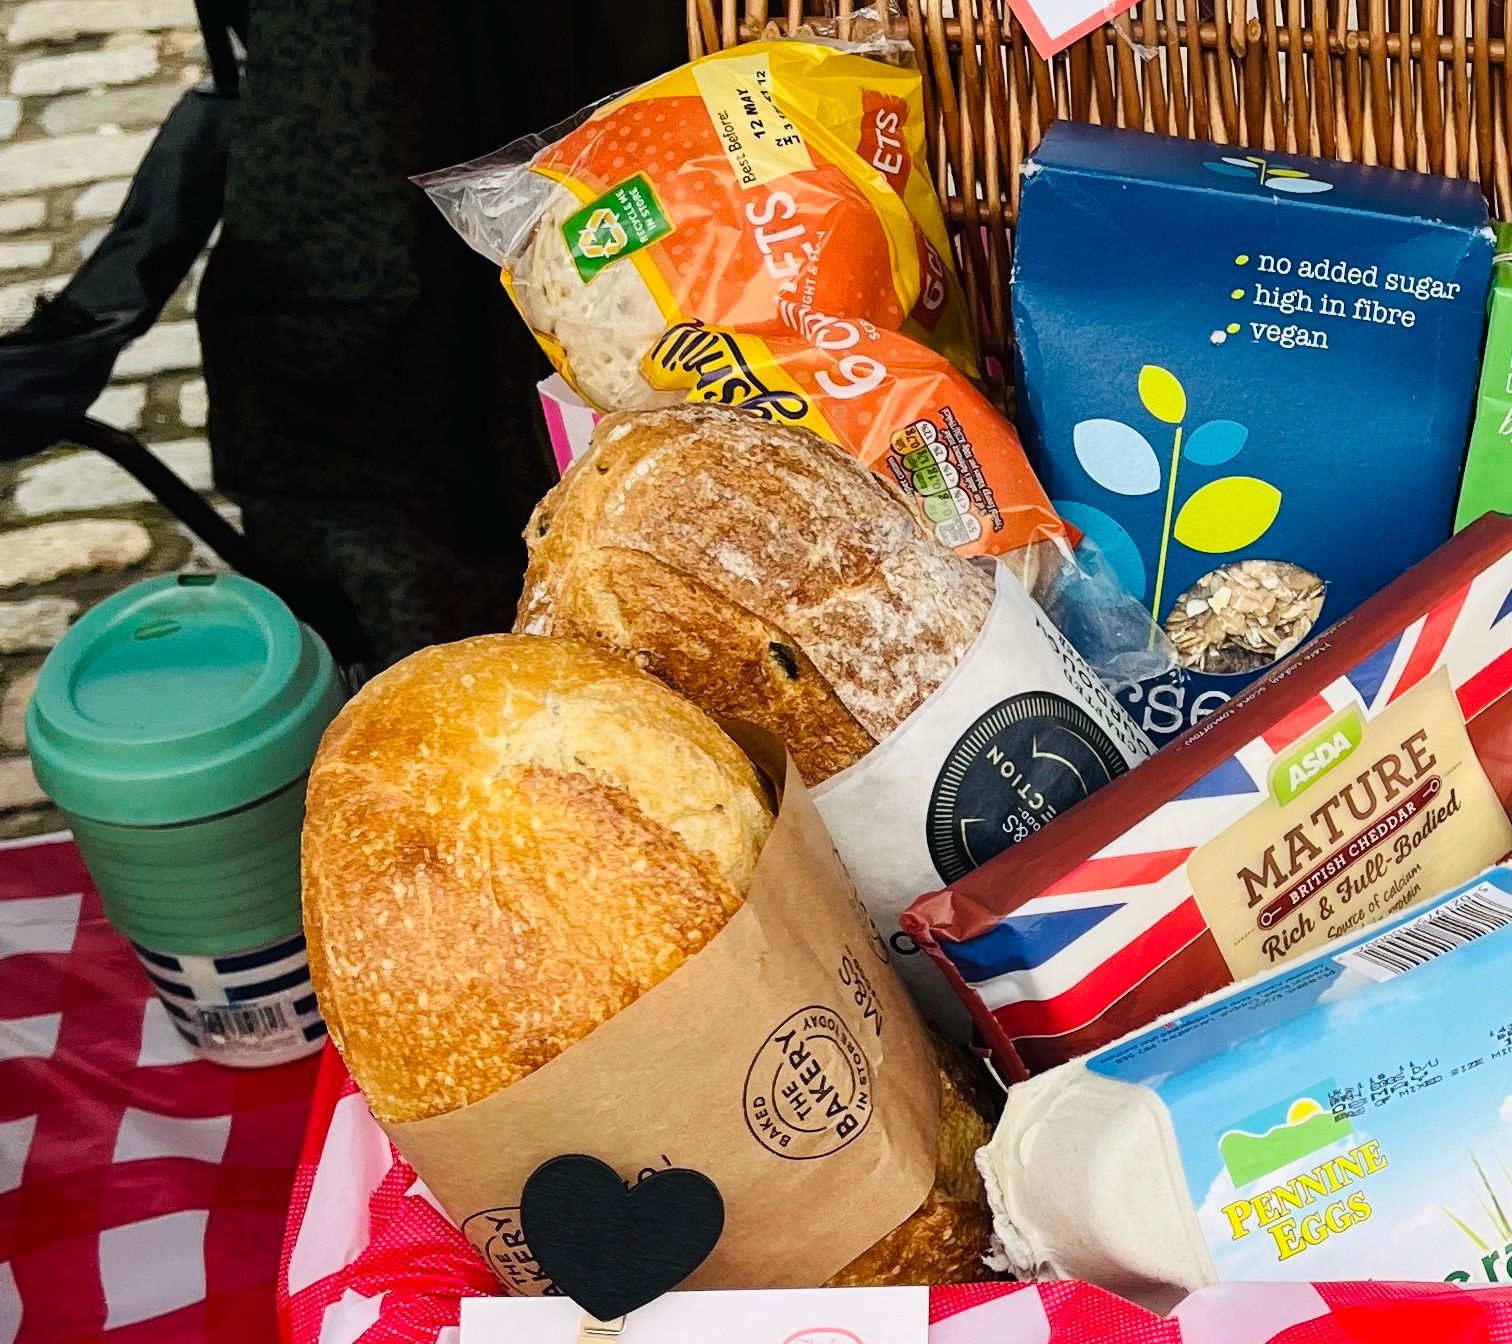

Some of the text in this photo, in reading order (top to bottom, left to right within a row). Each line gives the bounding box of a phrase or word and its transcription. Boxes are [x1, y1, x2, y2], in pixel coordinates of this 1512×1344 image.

[736, 87, 766, 139] 12 MAY
[717, 110, 757, 184] Best Before:
[615, 189, 648, 244] RECYCLE ME
[629, 186, 657, 231] IN STORE
[1253, 283, 1416, 328] high in fibre
[1257, 254, 1461, 301] no added sugar
[1250, 321, 1329, 349] vegan
[813, 354, 888, 400] 6
[1288, 731, 1352, 793] ASDA
[1237, 728, 1438, 909] MATURE
[1262, 788, 1463, 963] Rich & Full-Bodied
[1289, 801, 1417, 906] BRITISH CHEDDAR
[1327, 864, 1423, 941] Source of calcium
[838, 954, 884, 1037] M&S
[752, 1014, 868, 1147] BAKED IN STORE TODAY
[774, 1029, 859, 1140] BAKERY
[781, 1081, 813, 1122] THE
[1221, 1138, 1388, 1242] PENNINE
[1267, 1190, 1373, 1262] EGGS
[497, 1253, 528, 1286] THE
